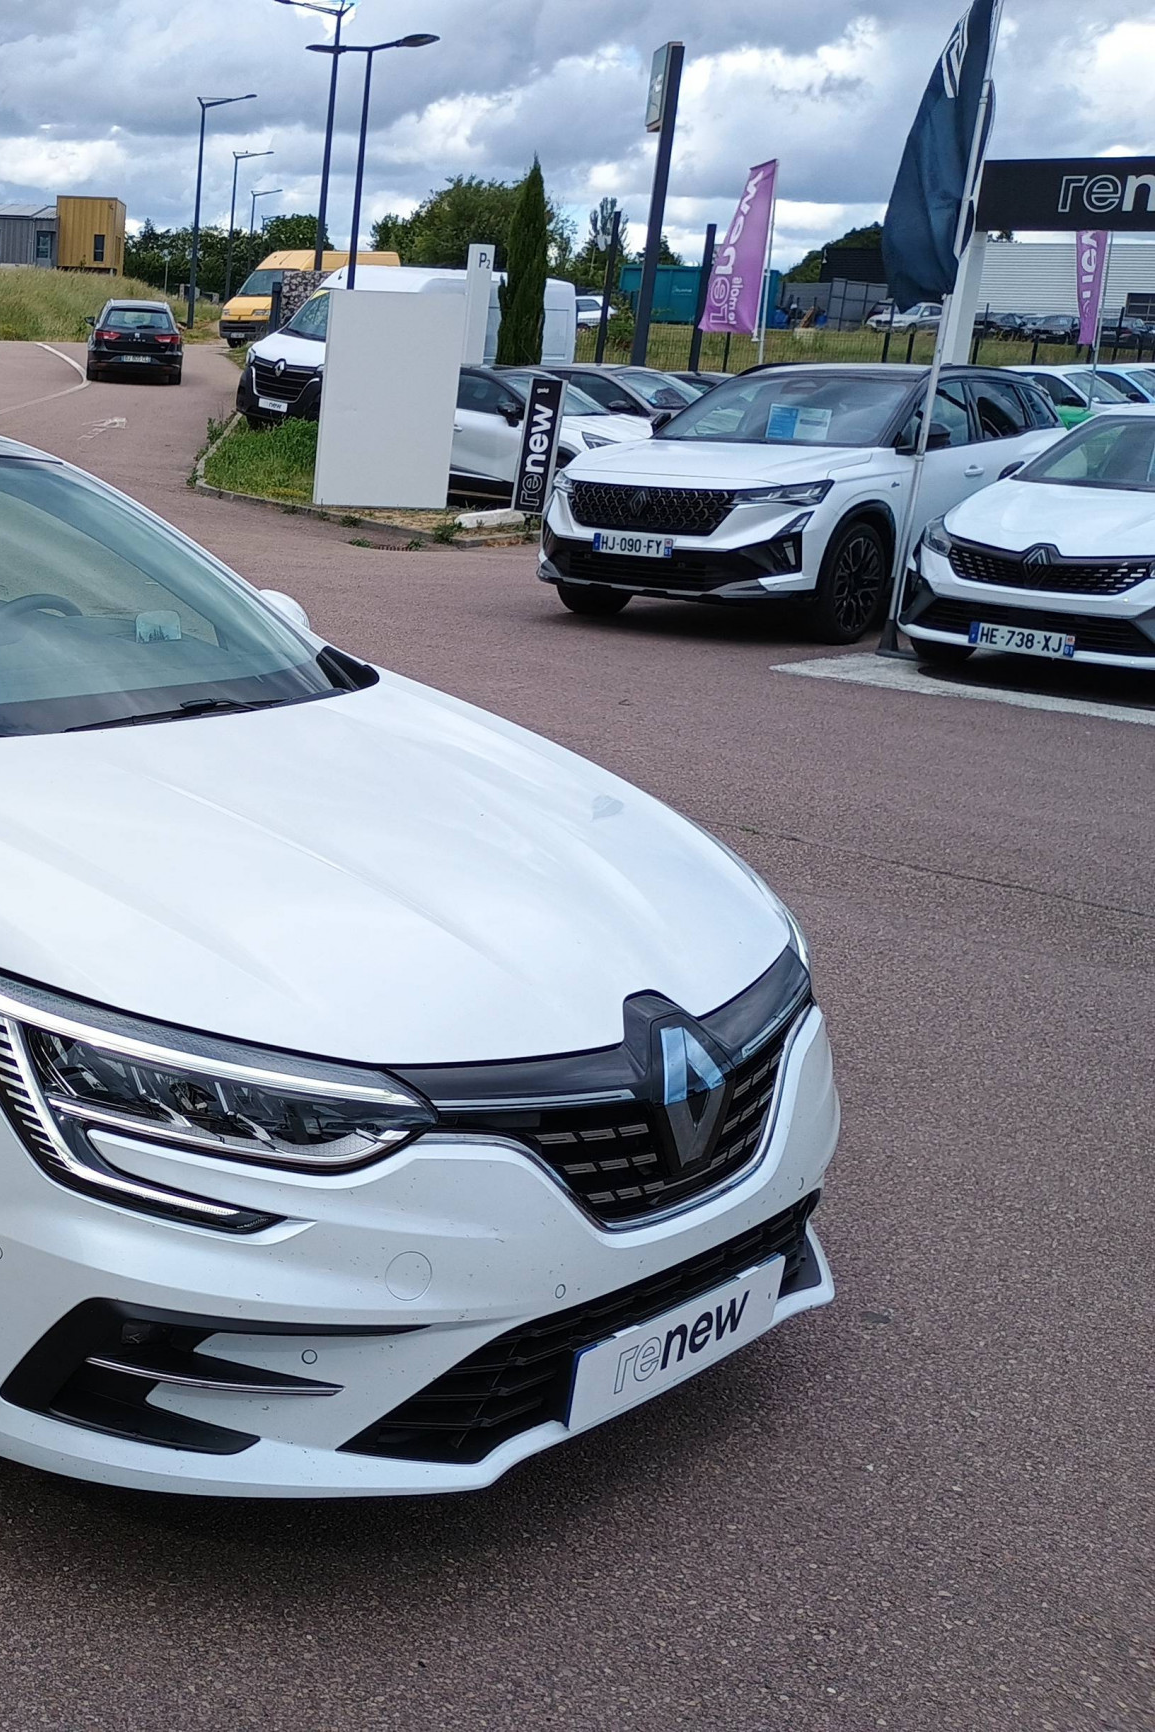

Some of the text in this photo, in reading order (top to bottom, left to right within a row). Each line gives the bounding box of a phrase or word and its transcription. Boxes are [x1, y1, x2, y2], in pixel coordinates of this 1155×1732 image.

[1058, 174, 1155, 213] ren
[520, 403, 553, 507] renew
[601, 535, 663, 555] HJ-090-FY
[980, 626, 1063, 653] HE-738-XJ
[613, 1289, 751, 1395] renew
